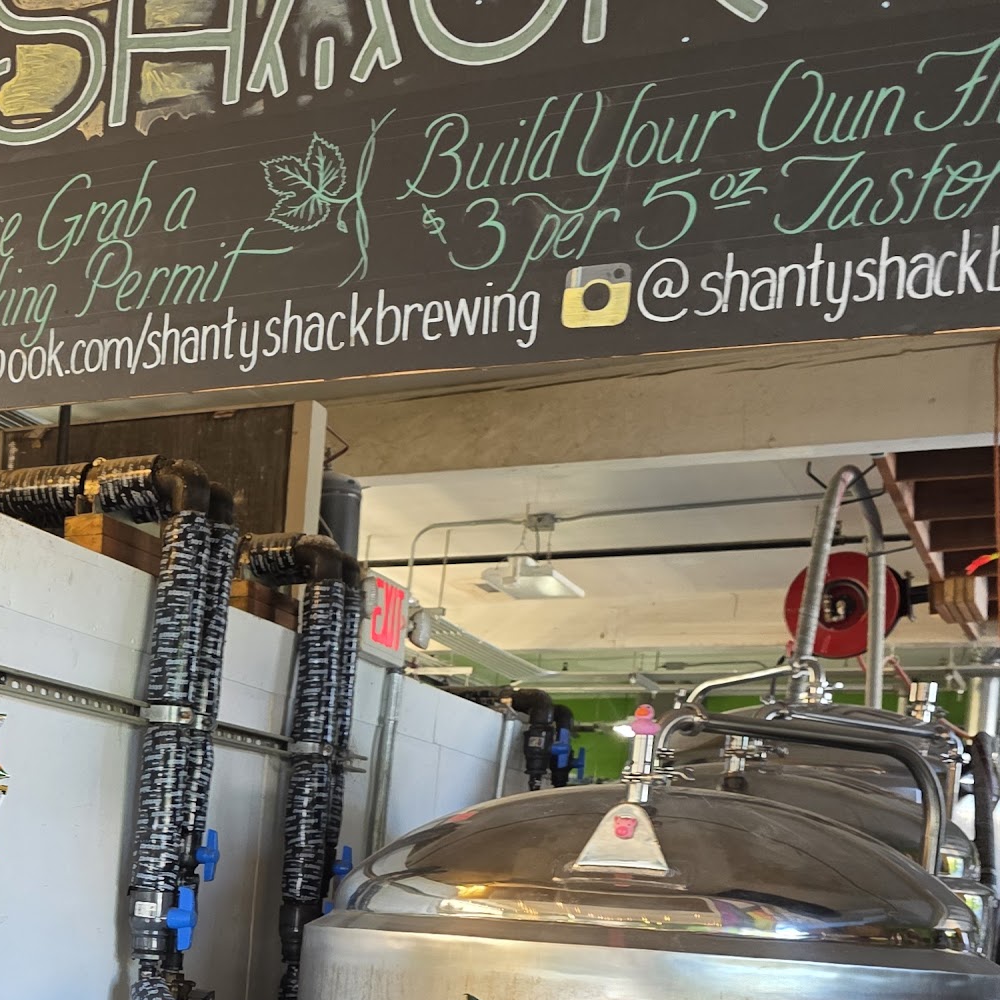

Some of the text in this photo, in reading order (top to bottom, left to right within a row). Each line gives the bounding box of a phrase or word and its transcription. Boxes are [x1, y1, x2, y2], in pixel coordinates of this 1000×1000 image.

[396, 96, 558, 200] Build
[512, 83, 736, 215] Your
[757, 59, 906, 152] Own
[38, 161, 157, 265] Grab
[164, 187, 196, 231] a
[508, 205, 620, 291] per
[75, 228, 294, 318] Permit
